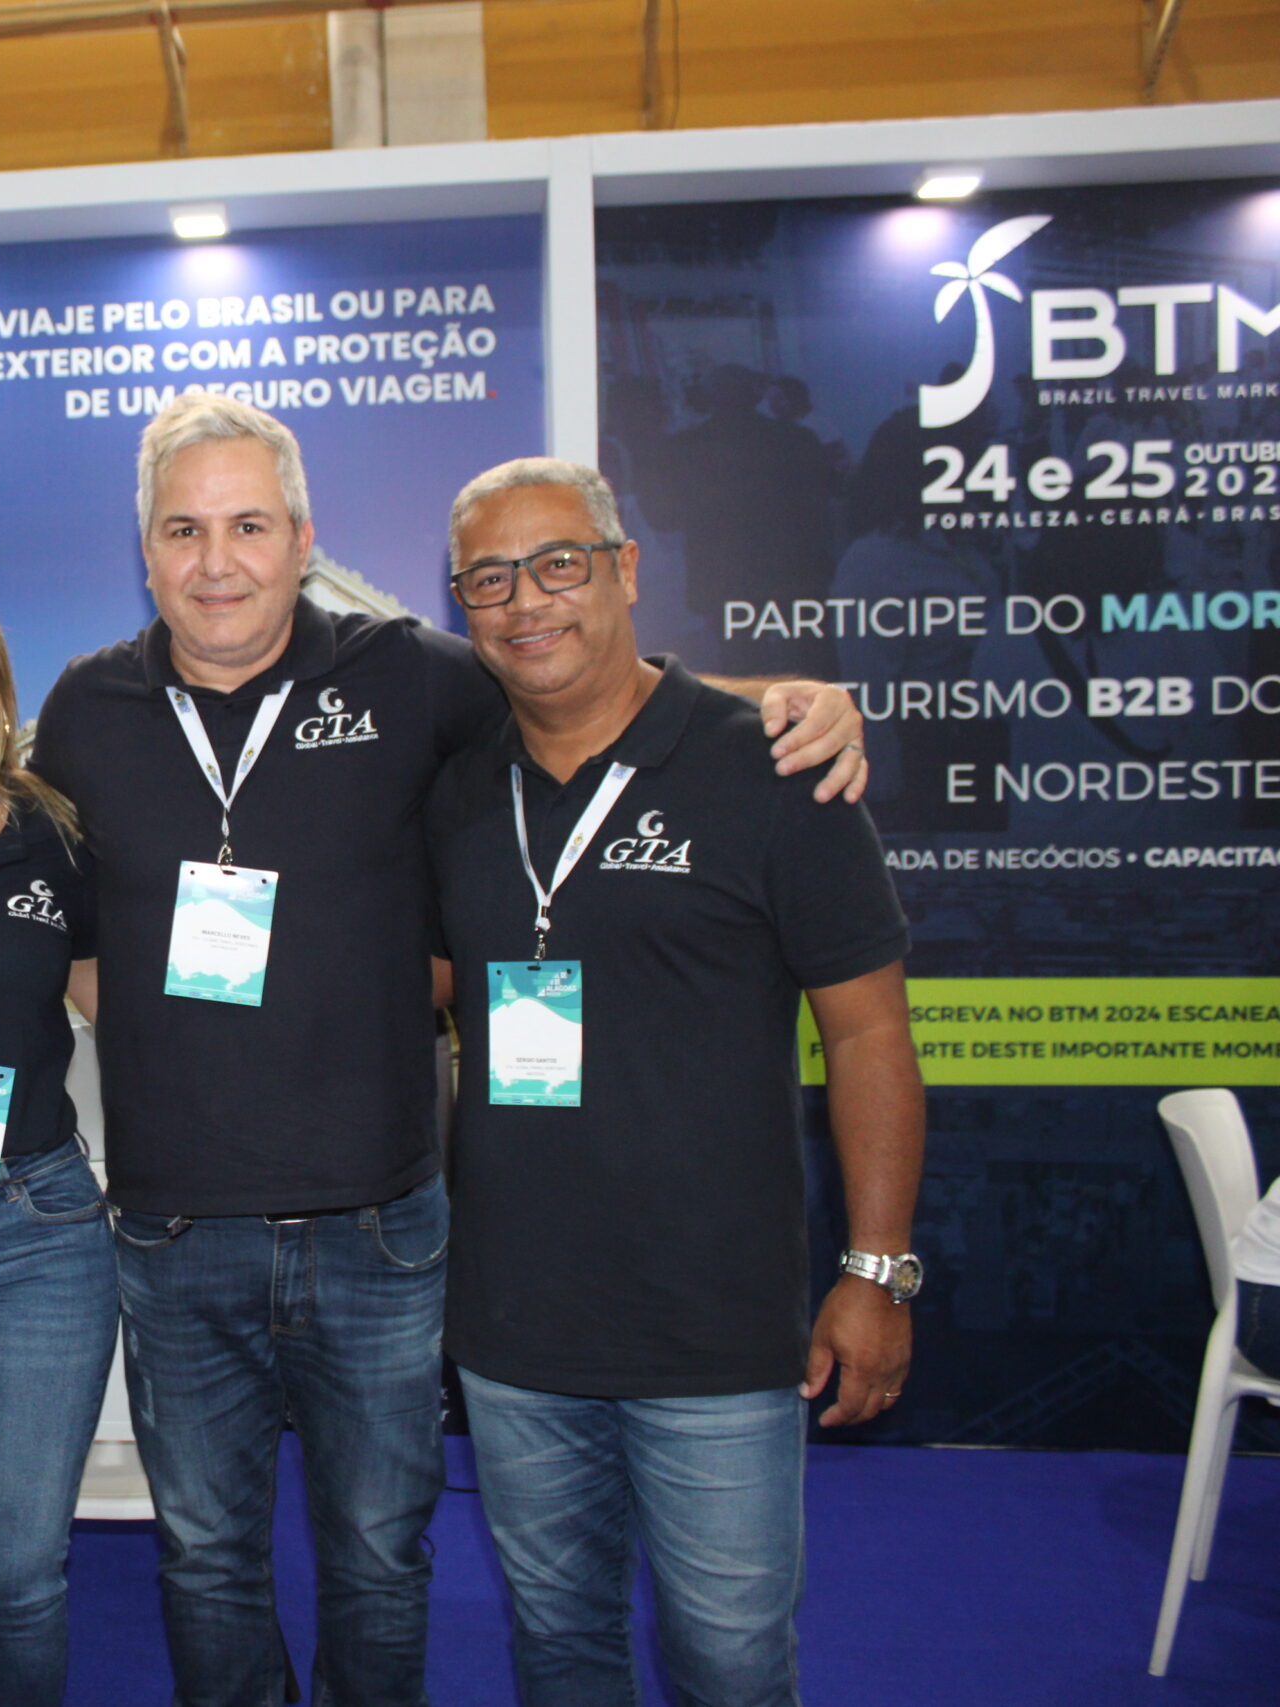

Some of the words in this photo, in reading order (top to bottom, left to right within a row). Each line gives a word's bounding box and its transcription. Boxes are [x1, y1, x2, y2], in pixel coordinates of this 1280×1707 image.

[102, 299, 190, 333] PELO
[197, 293, 324, 327] BRASIL
[330, 289, 385, 321] OU
[394, 283, 496, 318] PARA
[162, 339, 251, 372] COM
[258, 338, 287, 367] A
[293, 322, 496, 369] PROTEÇÃO
[1031, 282, 1280, 380] BTM
[65, 388, 111, 420] DE
[1039, 388, 1116, 405] BRAZIL
[1125, 385, 1208, 403] TRAVEL
[1184, 441, 1280, 465] OUTUB
[921, 444, 1016, 504] 24
[1028, 456, 1073, 501] e
[1085, 439, 1176, 500] 25
[1184, 465, 1278, 497] 202
[924, 510, 1079, 530] FORTALEZA
[1100, 504, 1190, 526] CEARÁ
[723, 595, 988, 641] PARTICIPE
[1005, 594, 1086, 636] DO
[1102, 591, 1280, 633] MAIOR
[1087, 677, 1193, 718] B2B
[1212, 675, 1280, 715] DO
[294, 709, 377, 742] GTA
[948, 764, 976, 803] E
[994, 759, 1280, 803] NORDESTE
[603, 837, 691, 866] GTA
[944, 849, 980, 870] DE
[986, 844, 1120, 870] NEGÓCIOS
[1145, 847, 1280, 868] CAPACITA
[7, 894, 68, 929] GTA
[1008, 1005, 1046, 1022] NO
[1049, 1005, 1099, 1022] BTM
[1105, 1005, 1161, 1022] 2024
[970, 1042, 1045, 1058] DESTE
[1052, 1041, 1206, 1058] IMPORTANTE
